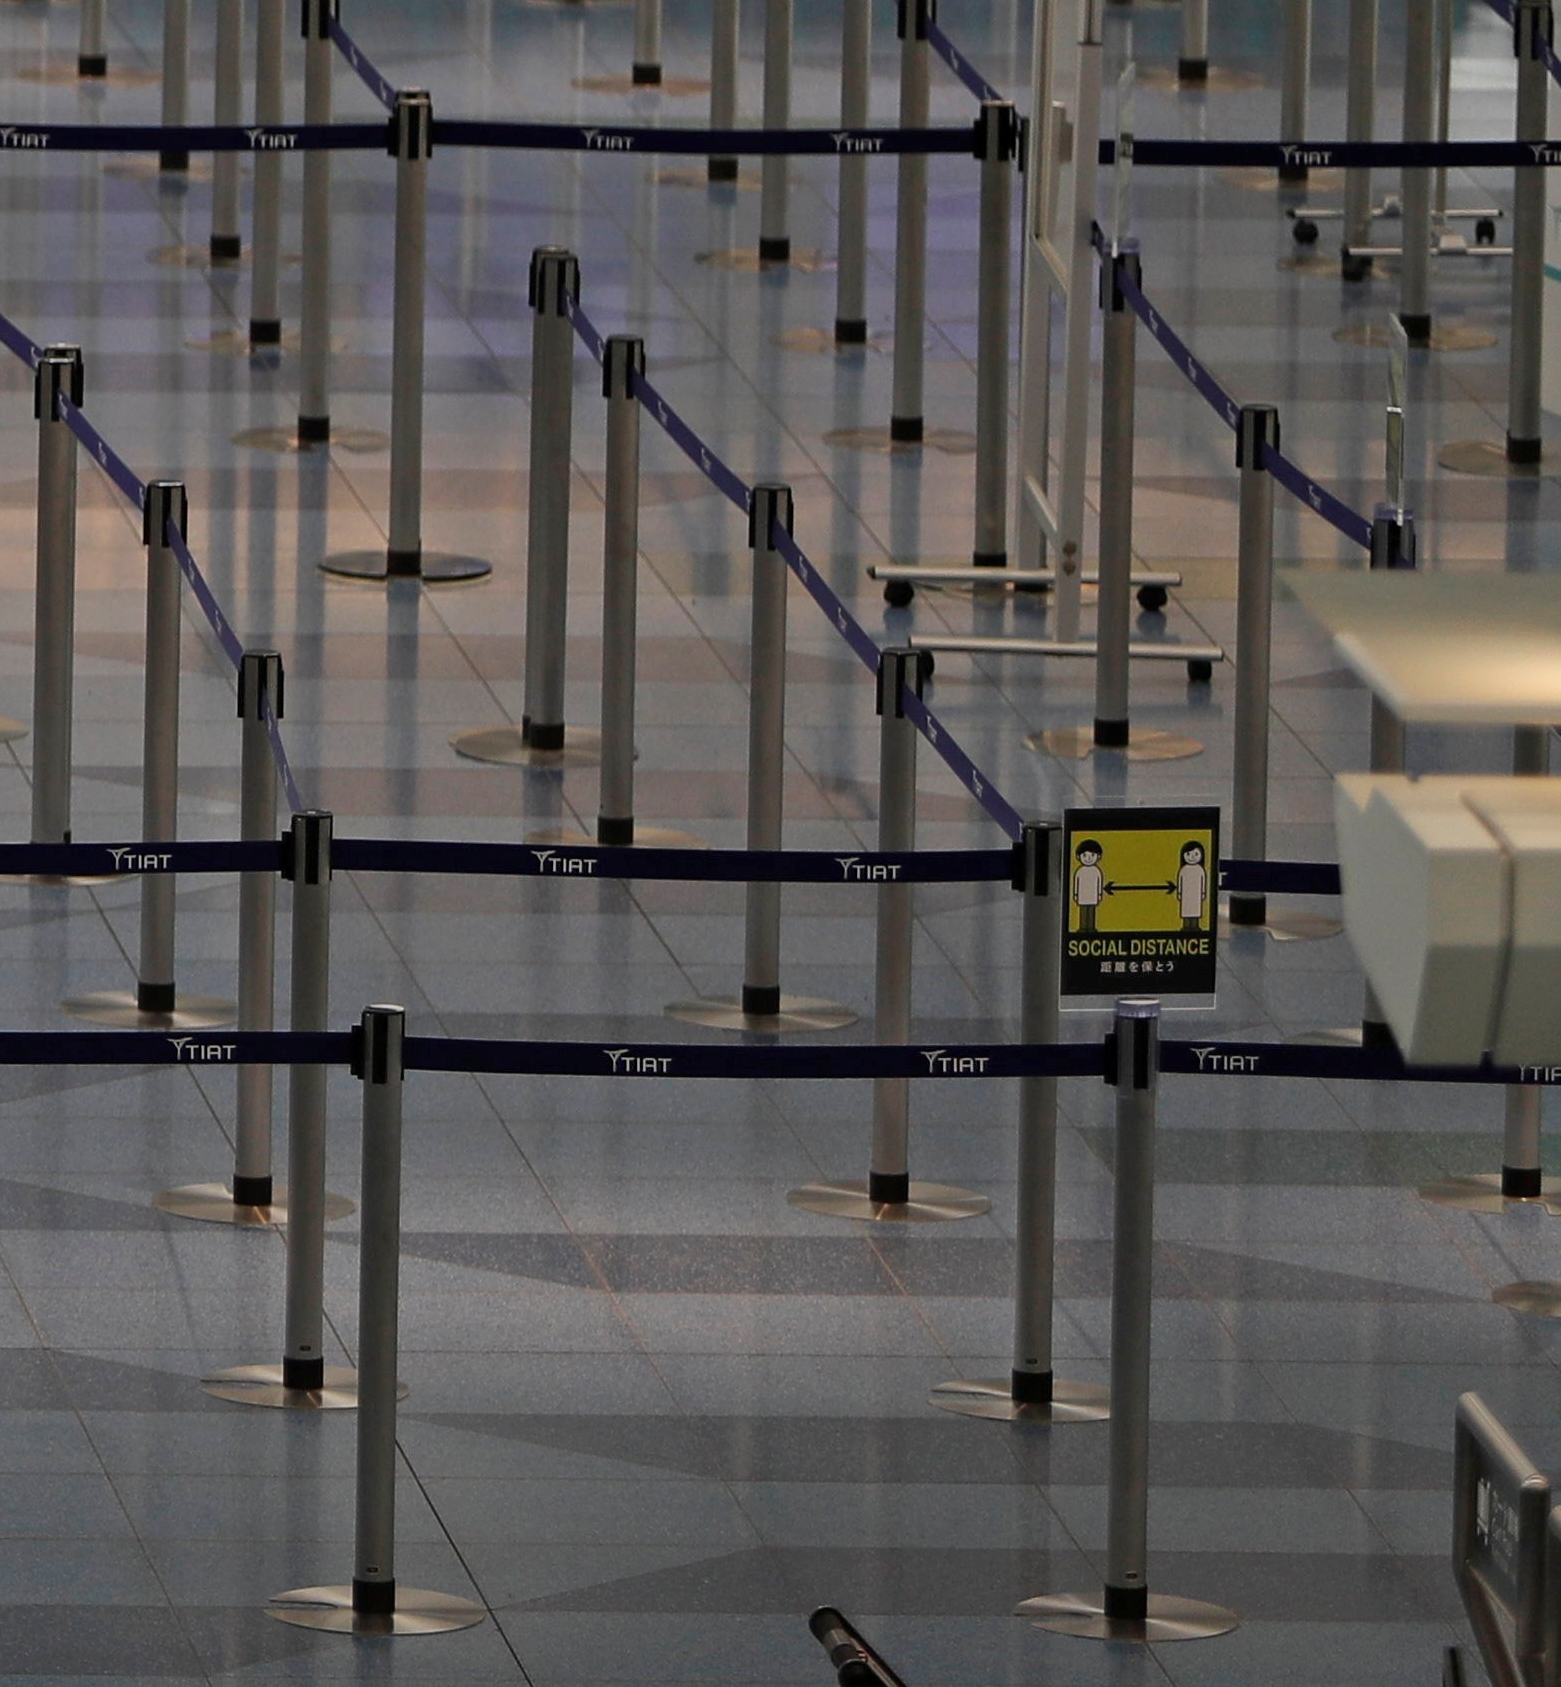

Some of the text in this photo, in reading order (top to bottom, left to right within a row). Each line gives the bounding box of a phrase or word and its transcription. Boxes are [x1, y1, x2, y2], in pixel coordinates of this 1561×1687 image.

[121, 852, 173, 869] TIAT
[852, 863, 901, 880] TIAT
[1068, 938, 1210, 957] SOCIAL DISTANCE
[185, 1043, 237, 1060] TIAT
[937, 1055, 990, 1072] TIAT
